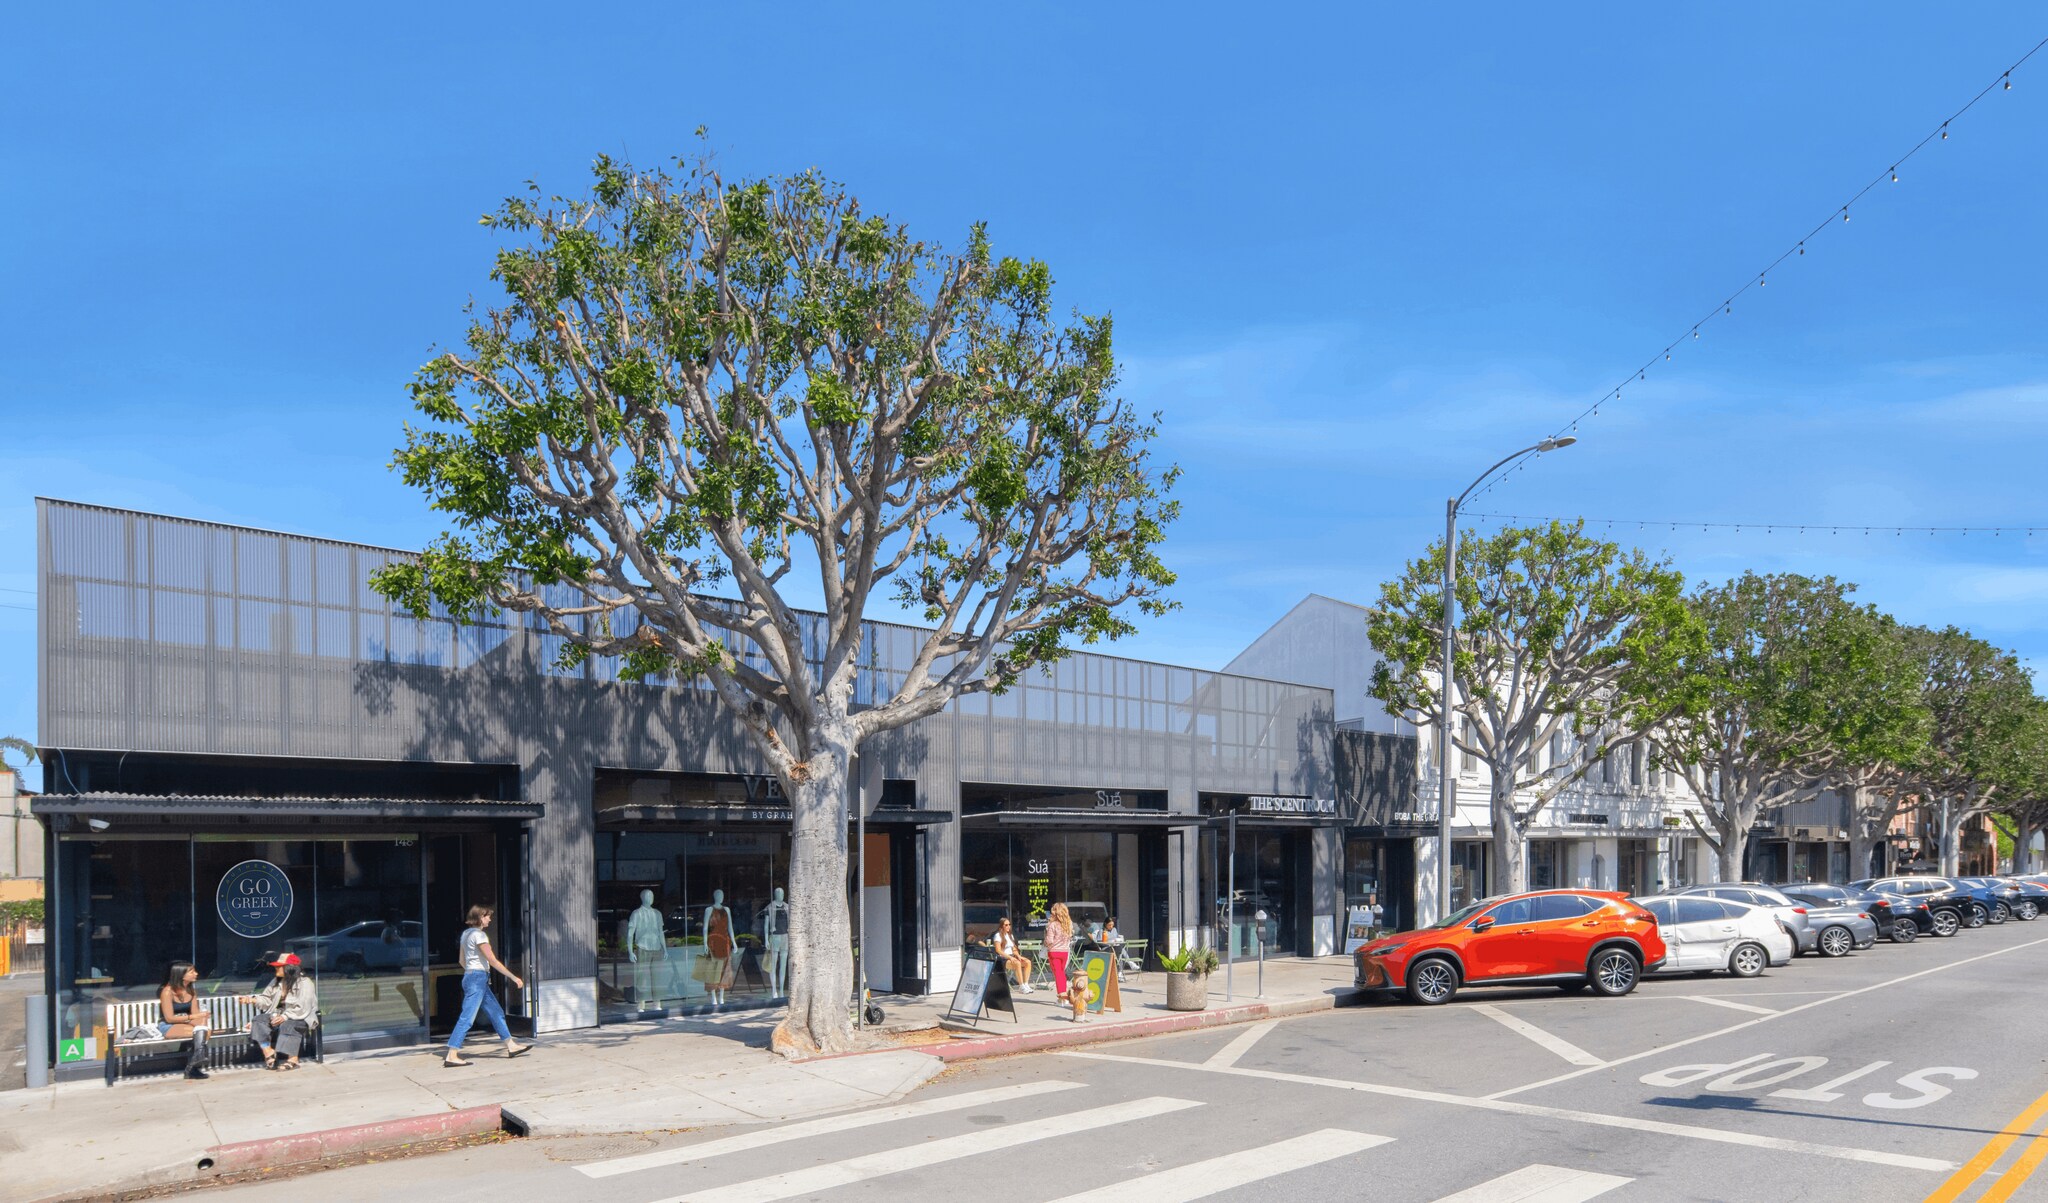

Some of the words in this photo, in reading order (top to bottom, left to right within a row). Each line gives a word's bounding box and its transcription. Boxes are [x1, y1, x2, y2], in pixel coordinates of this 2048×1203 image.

[1095, 790, 1121, 807] Suá
[1249, 796, 1272, 811] THE
[1273, 798, 1305, 812] SCENT
[1305, 800, 1335, 812] ROOM
[752, 811, 764, 819] BY
[1394, 812, 1411, 821] BOBA
[1028, 859, 1049, 873] Suá
[240, 878, 271, 895] GO
[231, 896, 279, 909] GREEK
[65, 1044, 80, 1057] A
[1639, 1053, 1979, 1109] STOP
